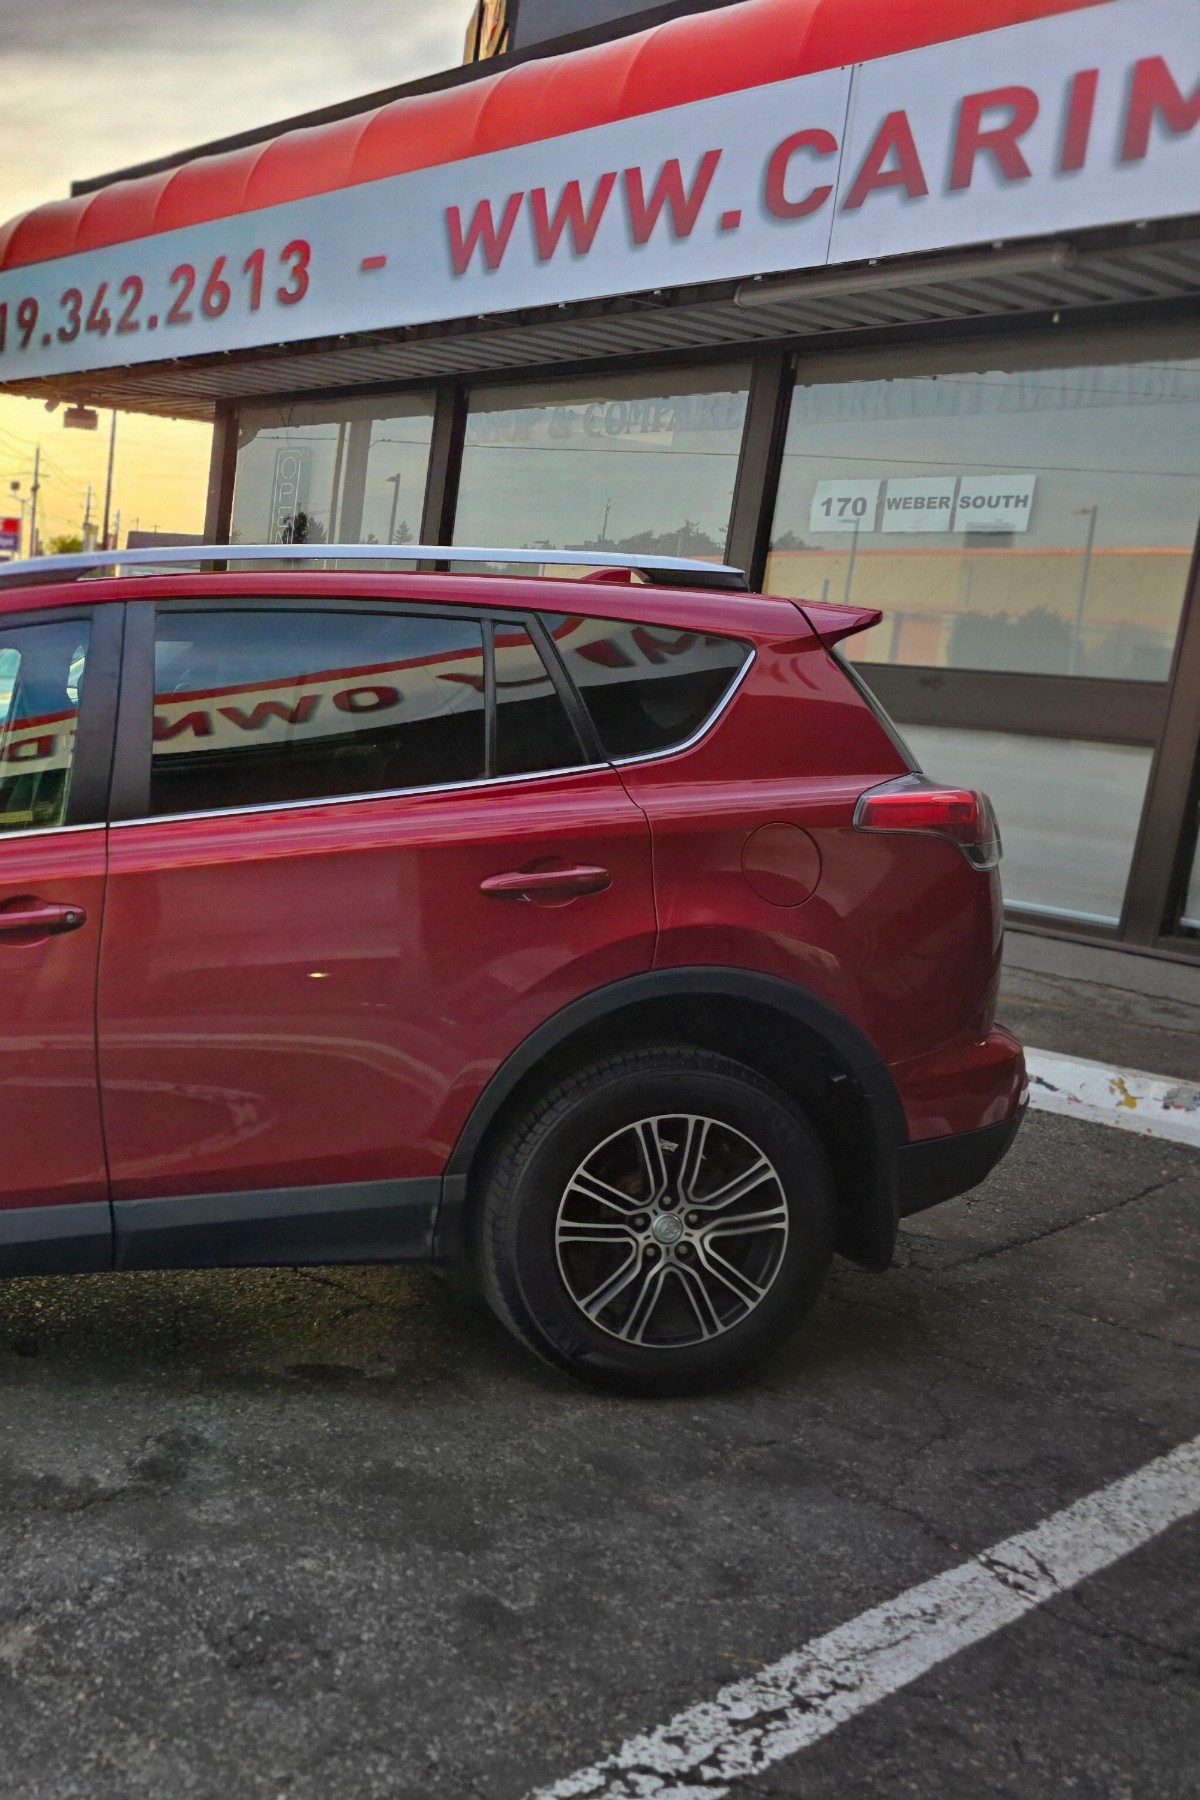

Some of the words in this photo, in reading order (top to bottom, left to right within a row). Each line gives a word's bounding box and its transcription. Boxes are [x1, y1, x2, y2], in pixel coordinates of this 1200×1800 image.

[821, 497, 867, 517] 170
[887, 496, 951, 510] WEBER
[959, 494, 1029, 509] SOUTH
